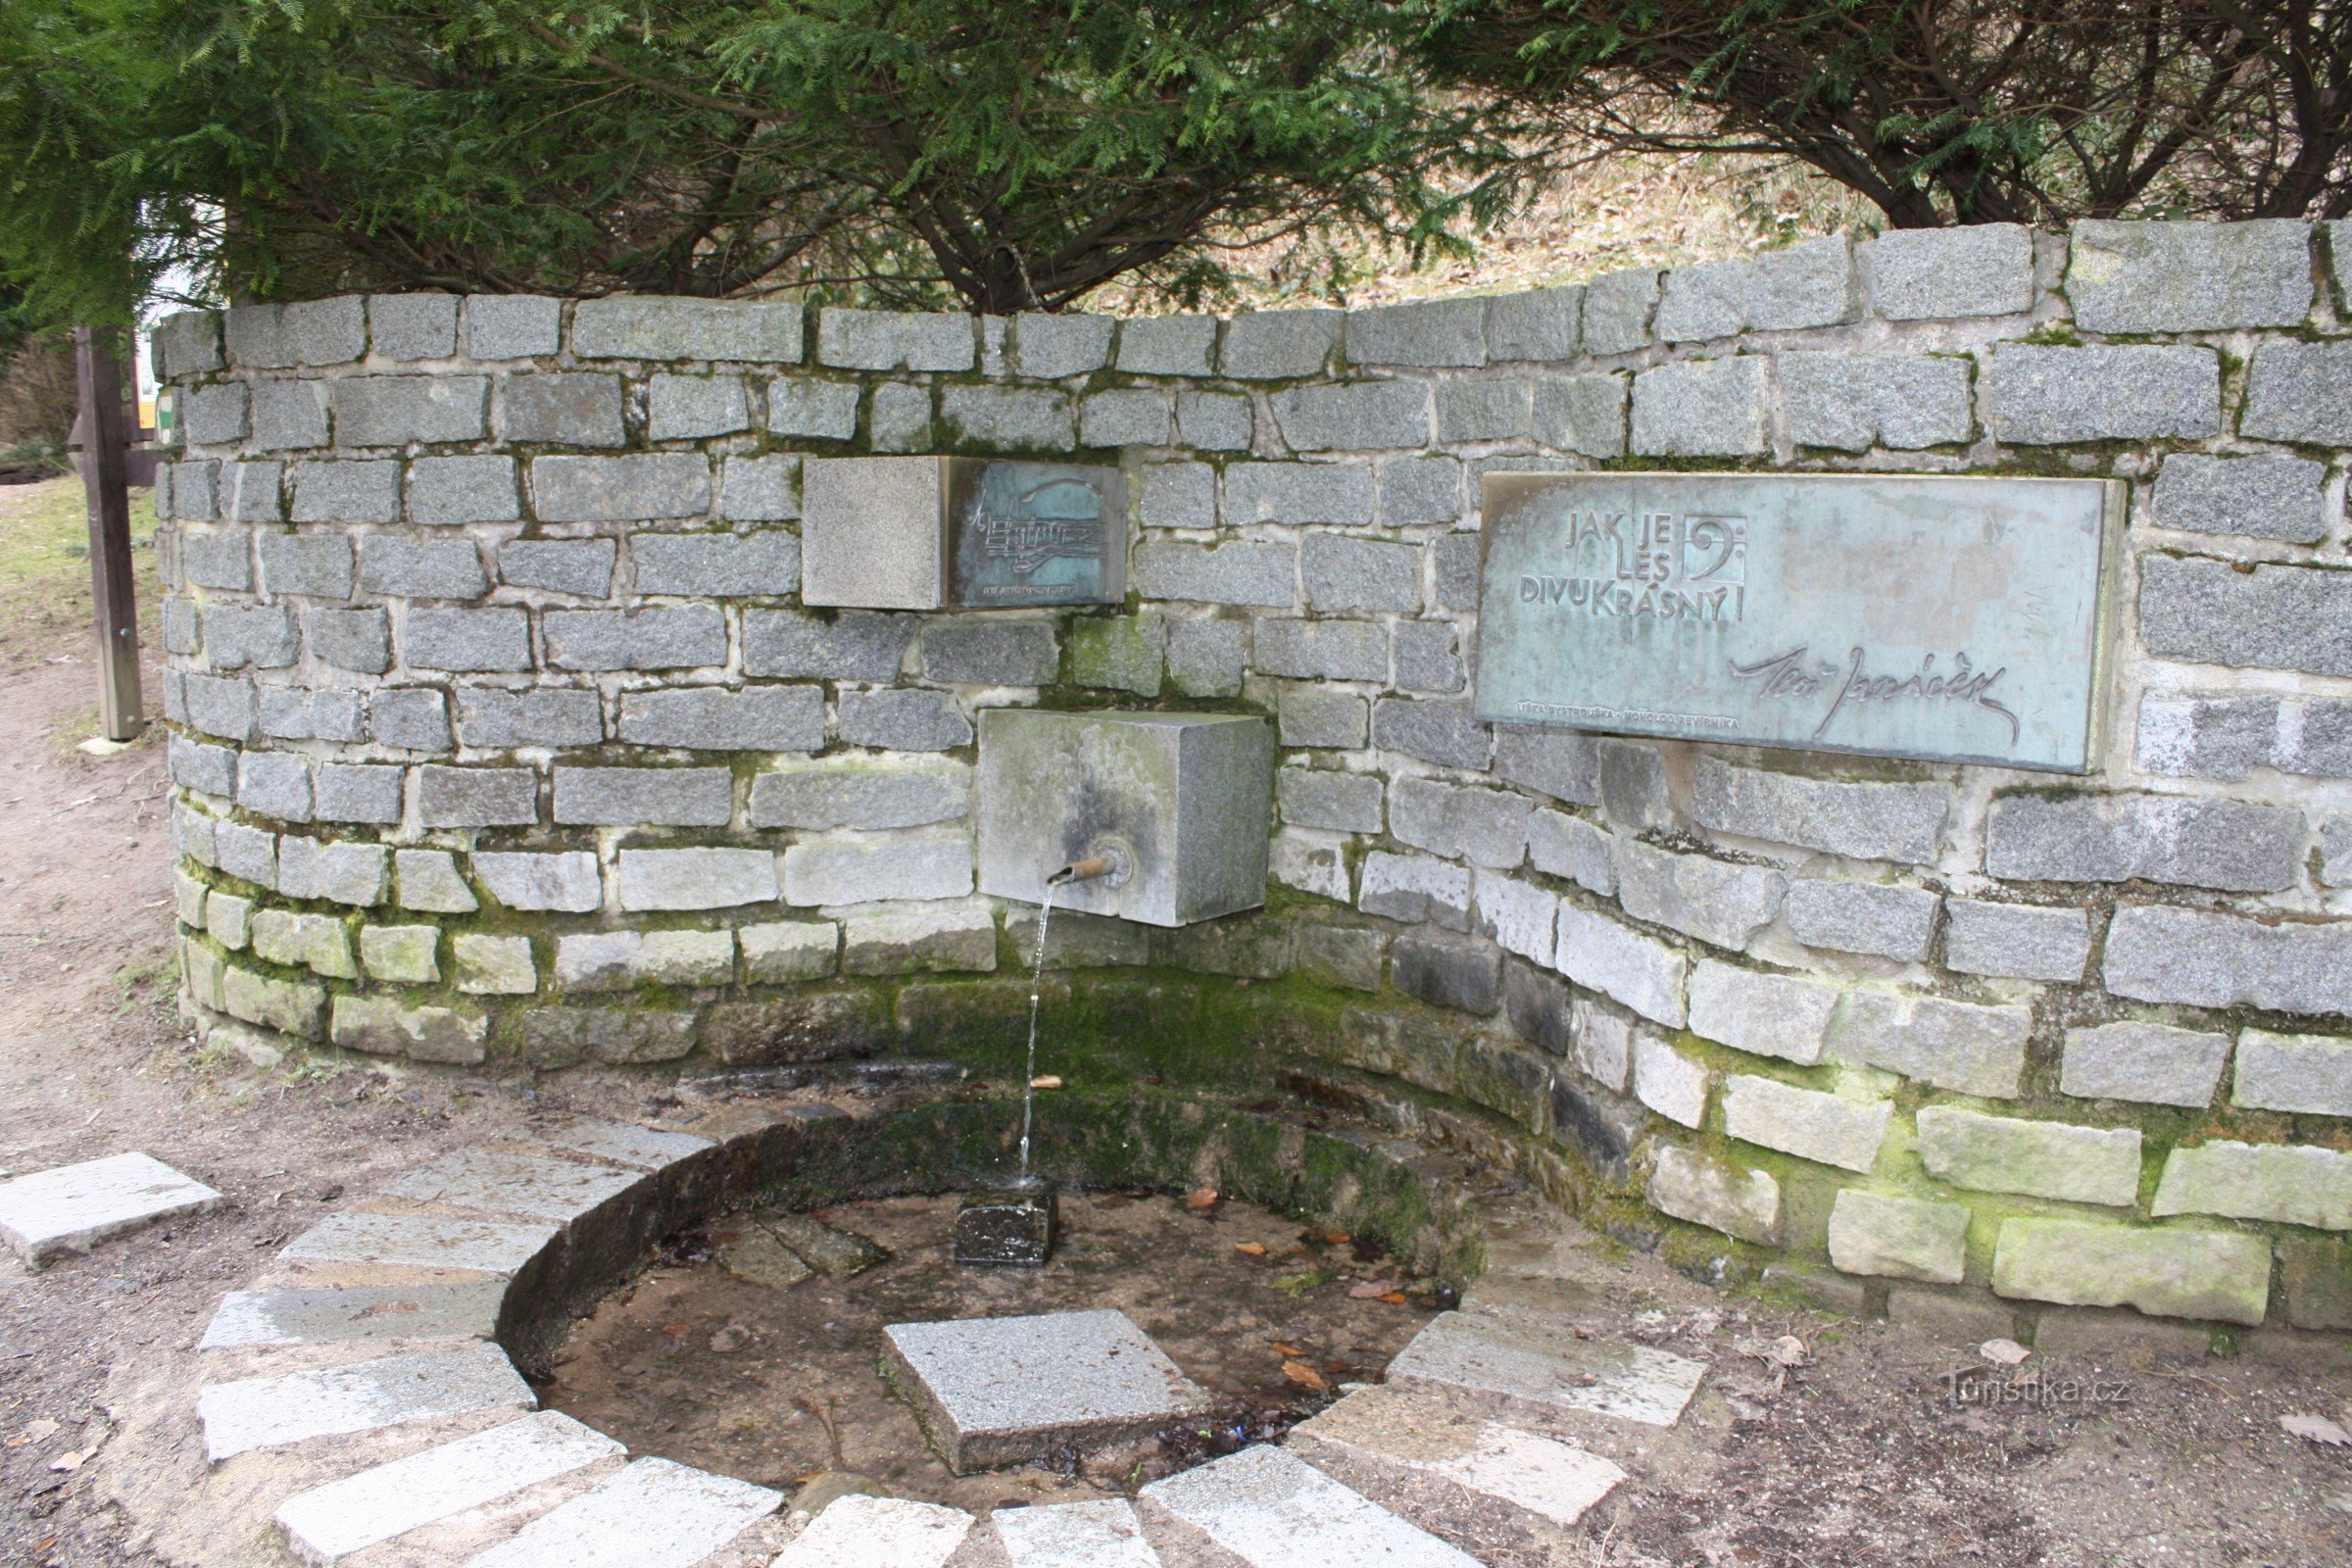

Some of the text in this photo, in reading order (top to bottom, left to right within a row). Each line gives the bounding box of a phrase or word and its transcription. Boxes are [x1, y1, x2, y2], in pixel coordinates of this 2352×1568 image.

[1565, 512, 1671, 550] JAK JE
[1616, 540, 1670, 581] LES
